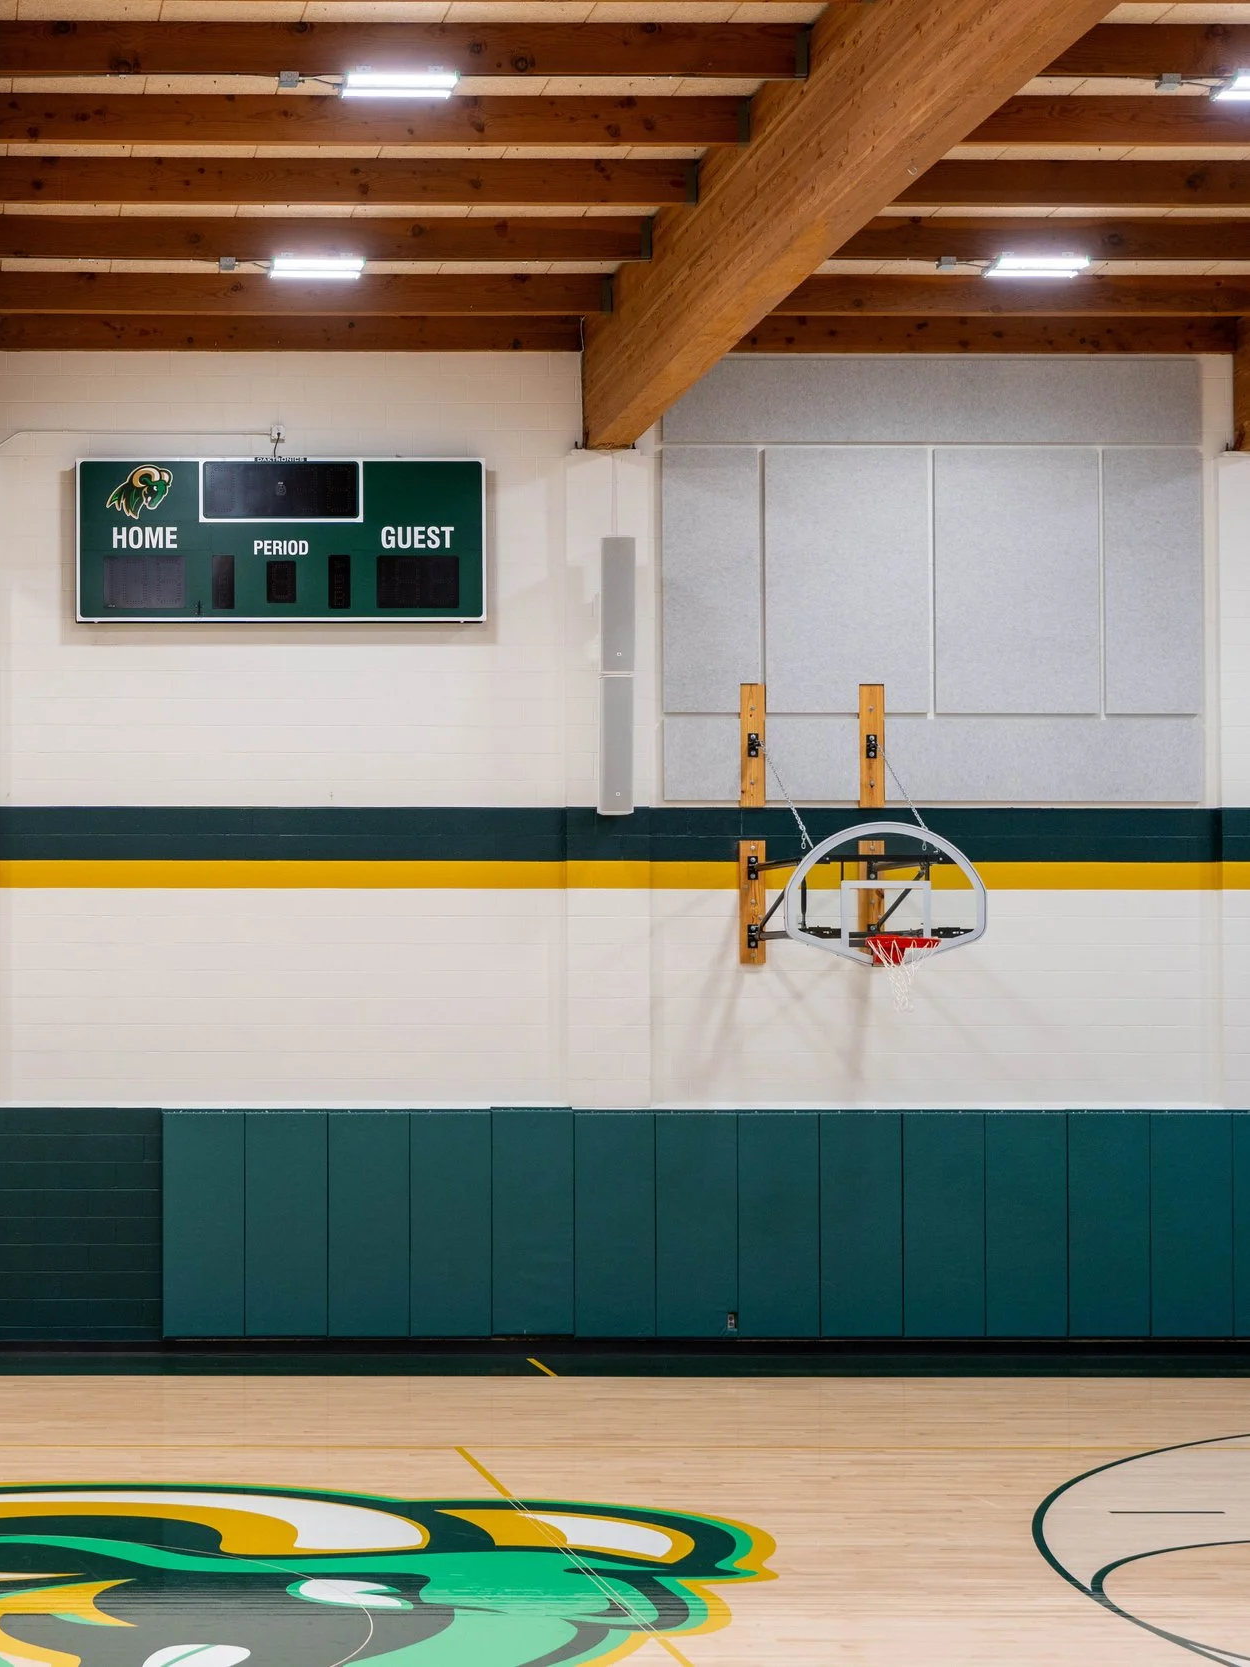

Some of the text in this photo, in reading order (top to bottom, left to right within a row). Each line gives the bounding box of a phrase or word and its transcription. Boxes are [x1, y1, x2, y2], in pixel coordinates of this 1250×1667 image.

[112, 526, 178, 549] HOME
[253, 540, 309, 556] PERIOD
[381, 526, 455, 549] GUEST
